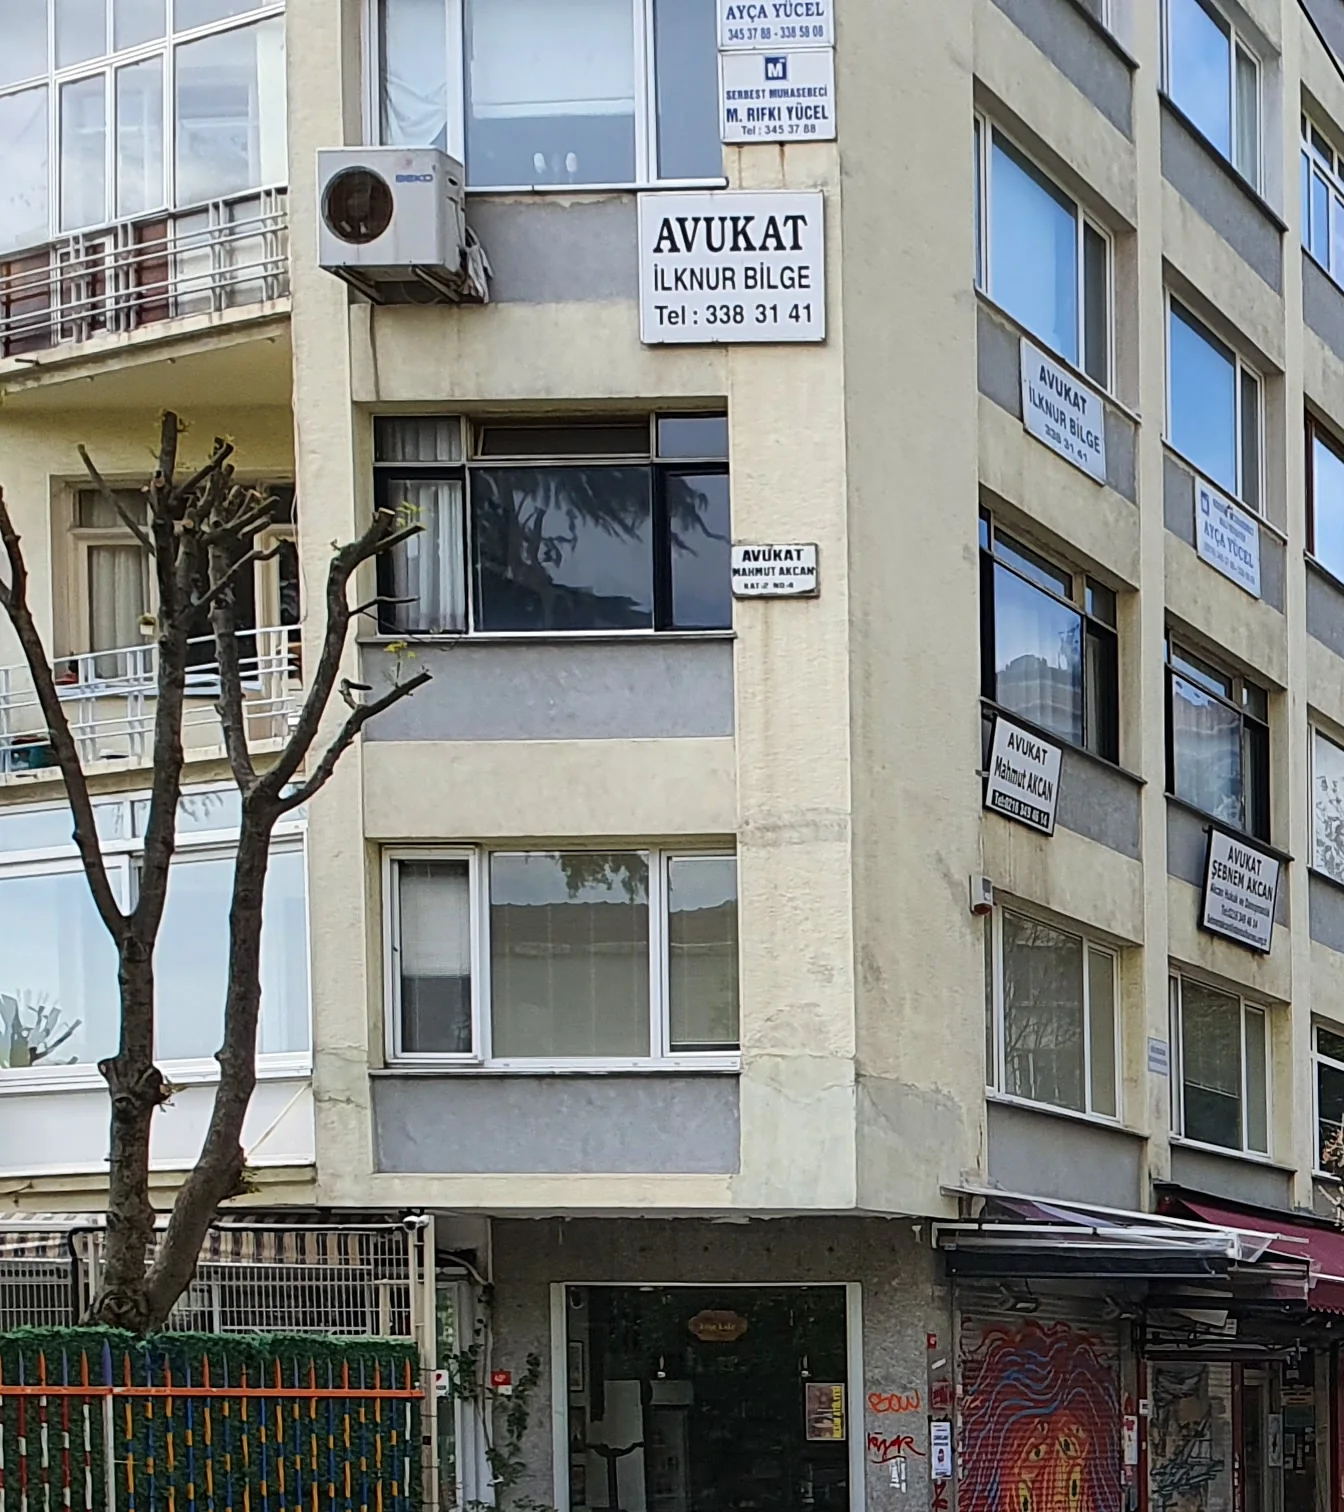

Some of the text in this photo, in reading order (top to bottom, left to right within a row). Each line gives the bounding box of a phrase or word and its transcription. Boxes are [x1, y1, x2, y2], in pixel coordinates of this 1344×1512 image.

[726, 0, 825, 23] AYÇA YÜCEL
[728, 28, 745, 41] 345
[747, 27, 758, 40] 37
[760, 27, 771, 39] 88
[780, 26, 796, 39] 338
[726, 84, 828, 100] SERBEST MUHASEBECİ
[726, 102, 829, 123] M. RIFKI YÜCEL
[764, 124, 784, 135] 345
[788, 124, 800, 133] 37
[803, 123, 816, 133] 88
[653, 215, 808, 253] AVUKAT
[654, 262, 811, 292] İLKNUR BİLGE
[654, 304, 686, 326] Tel
[705, 304, 745, 325] 338
[755, 303, 778, 323] 31
[788, 303, 812, 323] 41
[1039, 365, 1087, 415] AVUKAT
[1028, 380, 1101, 454] İLKNUR BİLGE
[1064, 438, 1075, 453] 31
[742, 548, 804, 562] AVUKAT
[1204, 520, 1226, 549] AYÇA
[1227, 536, 1255, 569] YÜCEL
[732, 566, 815, 577] MAHMUT AKCAN
[1007, 731, 1048, 766] AVUKAT
[994, 755, 1054, 803] Mahmut AKCAN
[1227, 845, 1262, 876] AVUKAT
[1211, 859, 1274, 903] ŞEBNEM AKCAN
